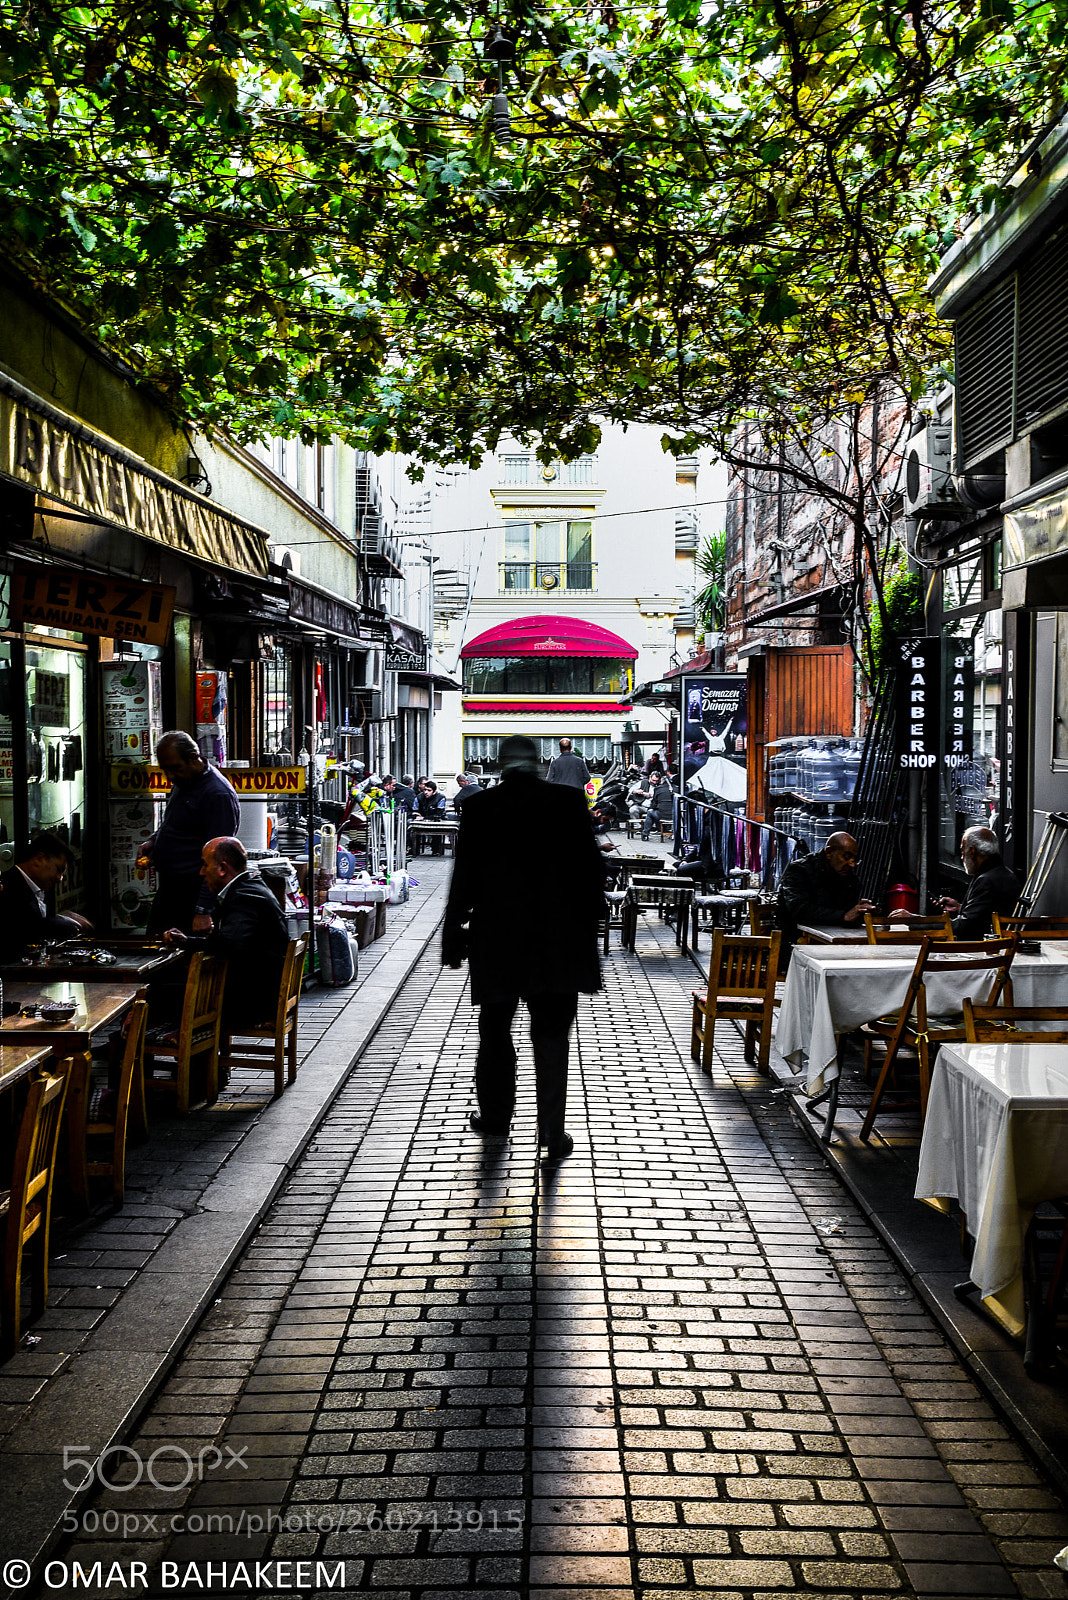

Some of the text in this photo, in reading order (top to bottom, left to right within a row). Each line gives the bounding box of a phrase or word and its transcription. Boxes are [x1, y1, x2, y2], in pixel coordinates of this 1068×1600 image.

[22, 604, 147, 638] KAMURAN ŞEN
[701, 686, 740, 698] Semazen
[701, 699, 739, 715] Dünyası
[910, 656, 926, 752] BARBER
[1006, 649, 1014, 810] BARBER
[900, 754, 936, 768] SHOP
[231, 771, 300, 790] NTOLON
